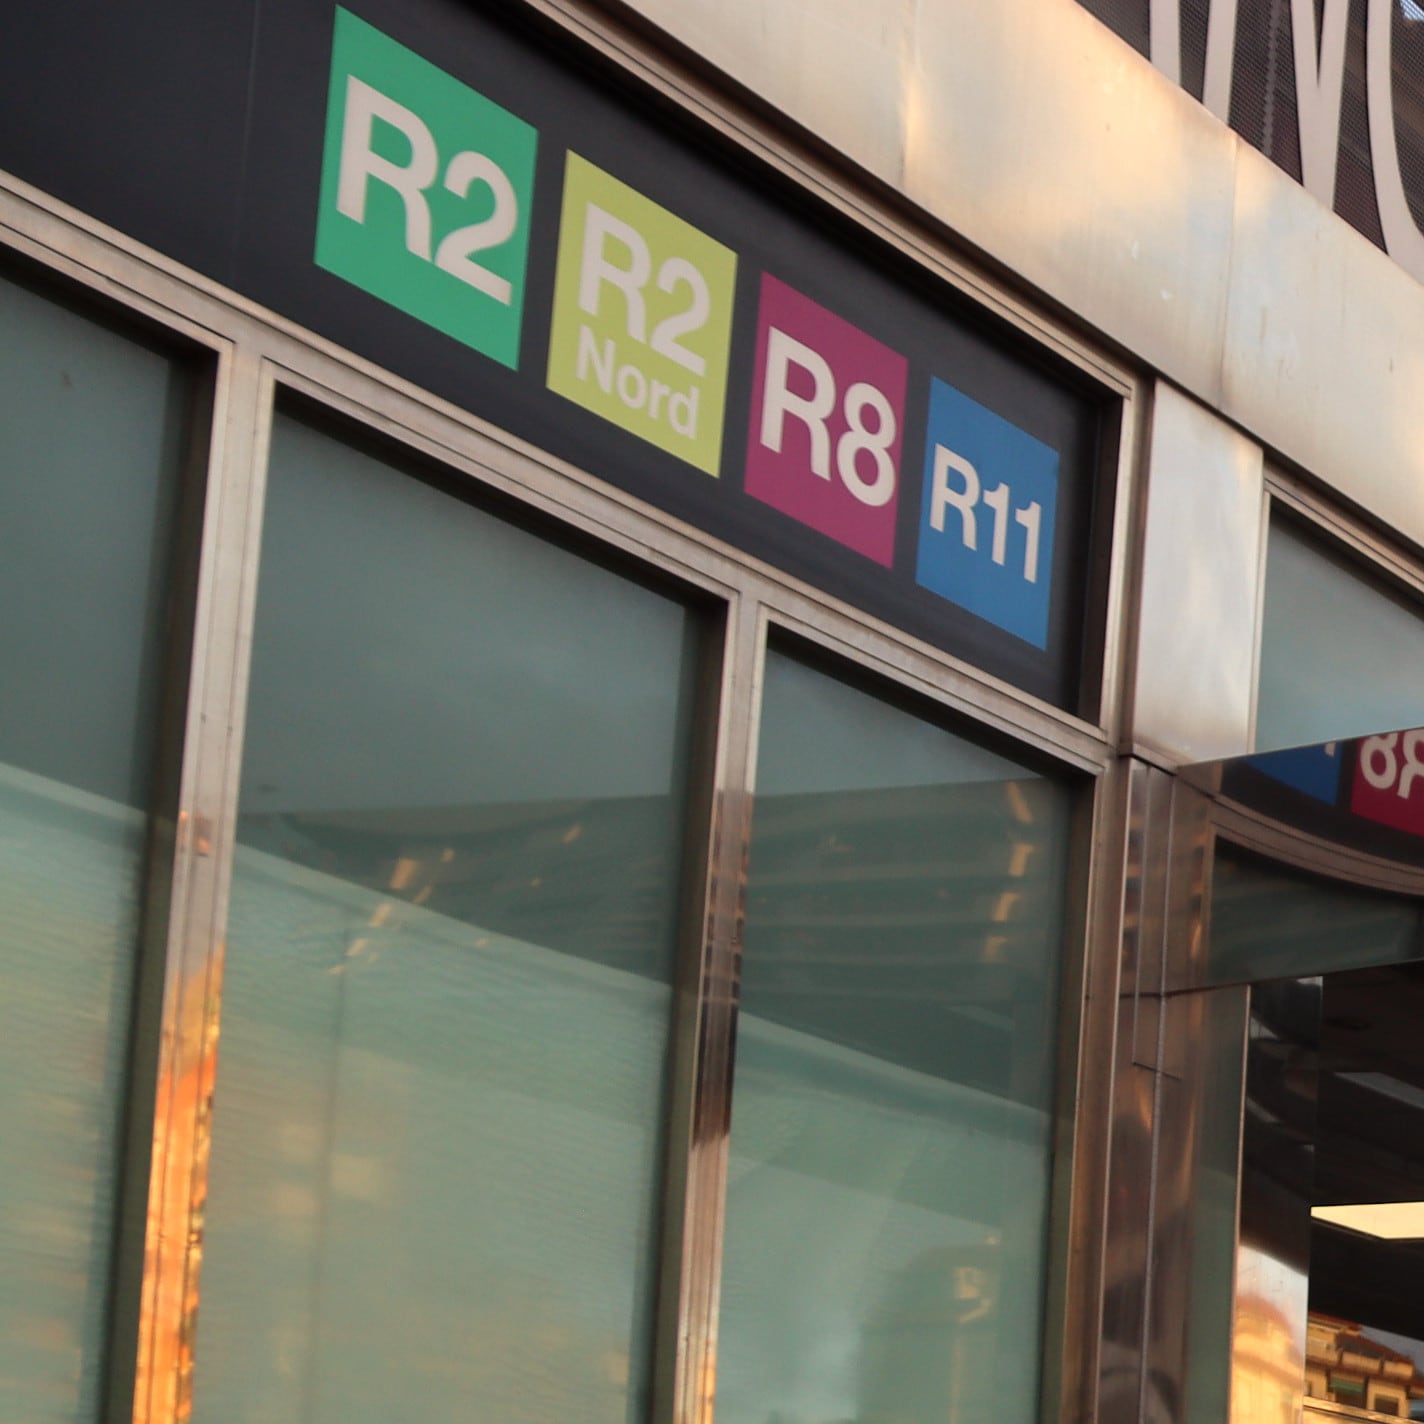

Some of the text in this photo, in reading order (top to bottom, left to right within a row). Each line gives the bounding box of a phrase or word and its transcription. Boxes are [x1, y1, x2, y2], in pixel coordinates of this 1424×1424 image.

[336, 73, 519, 306] R2
[576, 201, 711, 377] R2
[575, 323, 699, 440] Nord
[759, 326, 896, 508] R8
[928, 444, 1043, 584] R11
